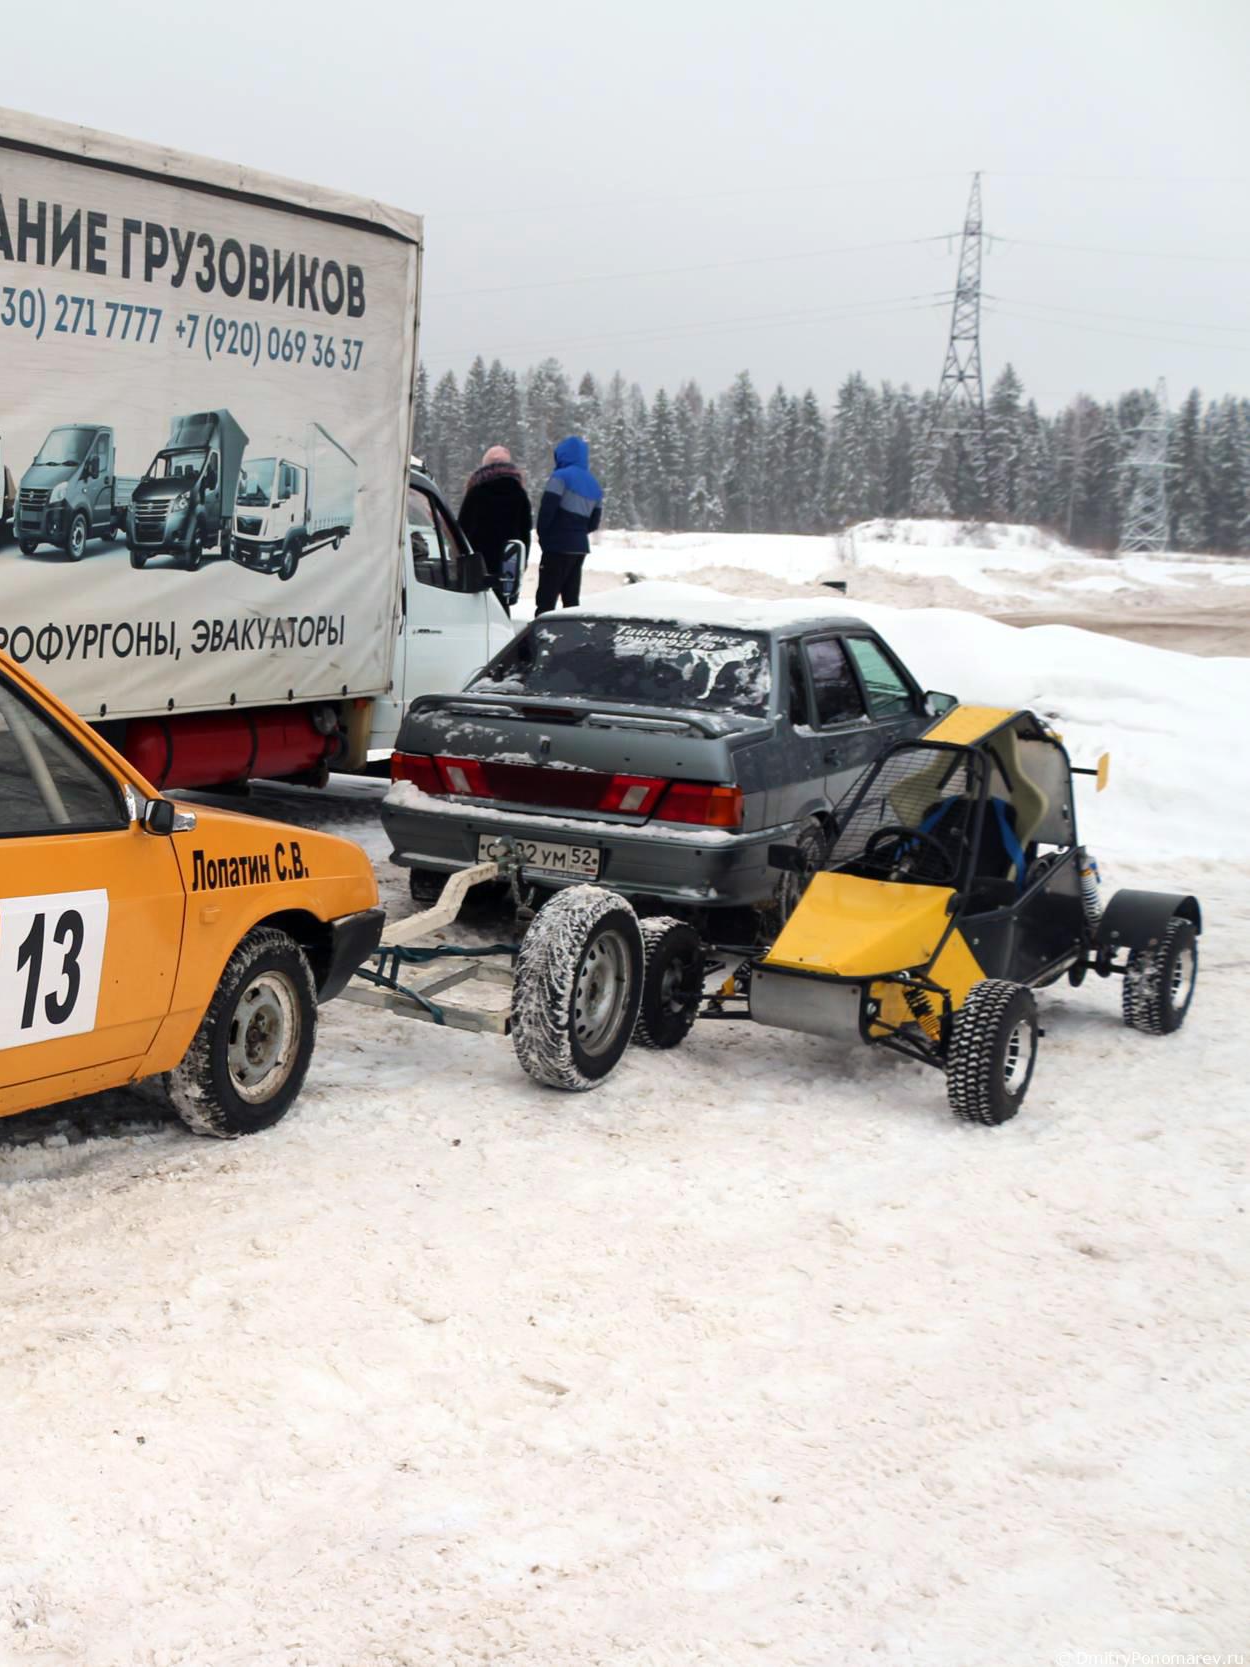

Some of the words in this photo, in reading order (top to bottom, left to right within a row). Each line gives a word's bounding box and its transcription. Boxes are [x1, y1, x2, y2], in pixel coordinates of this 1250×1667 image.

[121, 217, 366, 318] ГРУЗОВИКОВ
[54, 294, 97, 336] 271
[105, 302, 163, 343] 7777
[175, 314, 199, 349] +7
[205, 313, 262, 367] (920)
[267, 326, 306, 363] 069
[311, 334, 335, 369] 36
[341, 339, 364, 371] 37
[191, 615, 346, 653] ЭВАКУАТОРЫ
[615, 625, 693, 640] Тайский
[192, 850, 270, 891] Лопатин
[274, 842, 309, 881] С.В.
[571, 848, 592, 865] 52
[17, 909, 84, 1029] 13
